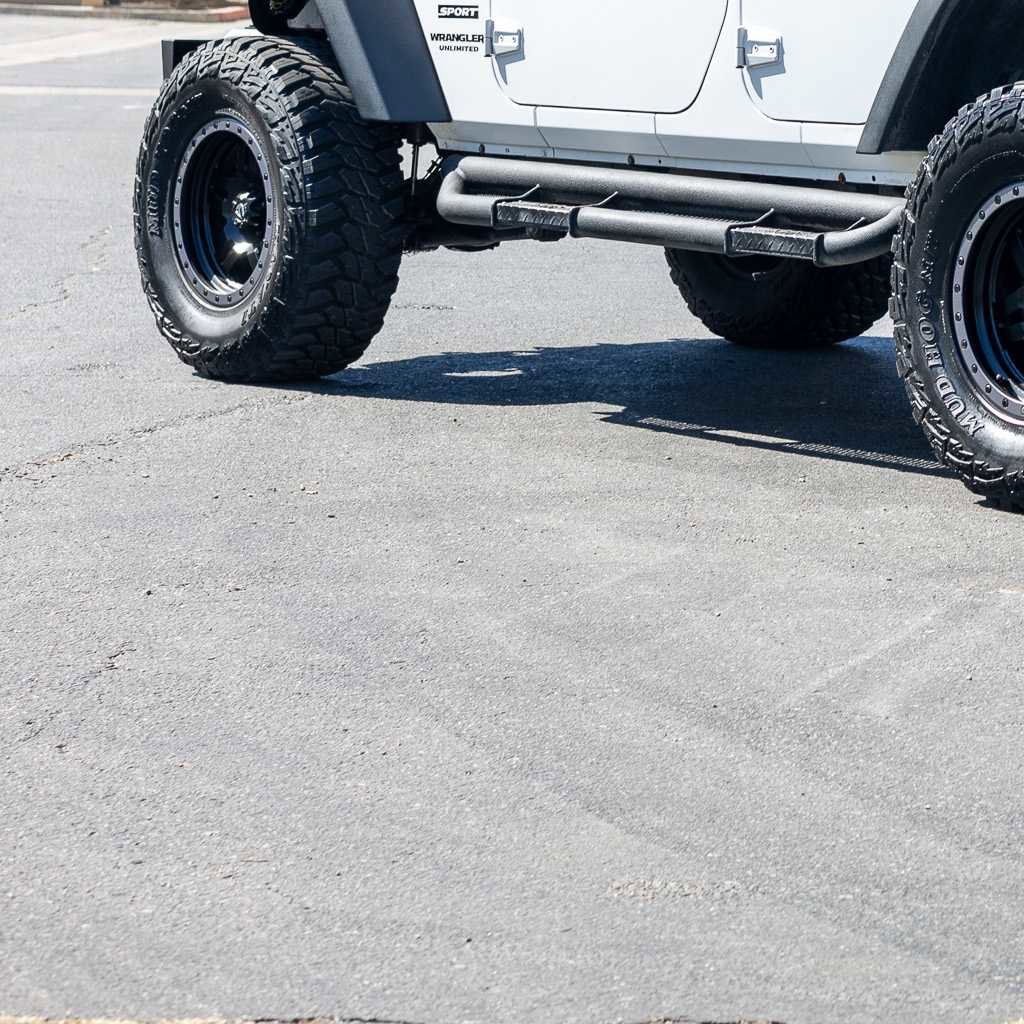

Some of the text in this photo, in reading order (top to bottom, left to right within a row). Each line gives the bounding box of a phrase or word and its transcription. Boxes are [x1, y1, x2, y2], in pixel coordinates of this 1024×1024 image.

[439, 7, 478, 17] SPORT
[431, 33, 484, 43] WRANGLER
[915, 290, 943, 369] HOG
[936, 375, 985, 437] MUD
